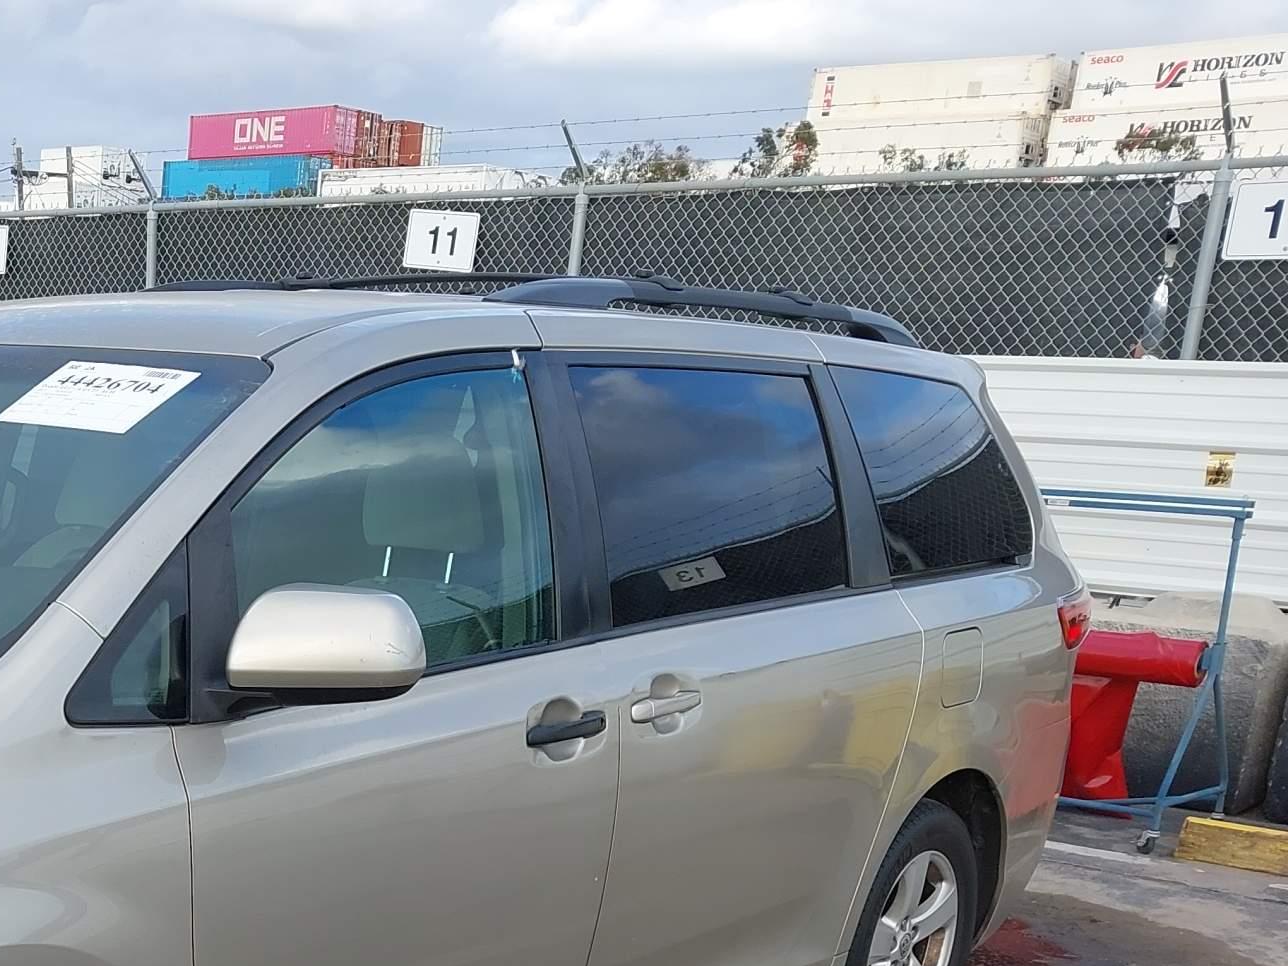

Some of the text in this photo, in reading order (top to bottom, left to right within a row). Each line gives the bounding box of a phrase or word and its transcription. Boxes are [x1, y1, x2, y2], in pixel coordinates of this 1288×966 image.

[1090, 55, 1124, 65] seaco
[1192, 51, 1286, 72] HORIZON
[1062, 114, 1095, 123] seaco
[1162, 116, 1253, 133] HORIZN
[234, 116, 286, 143] ONE
[428, 225, 458, 256] 11
[57, 374, 165, 394] 44426704
